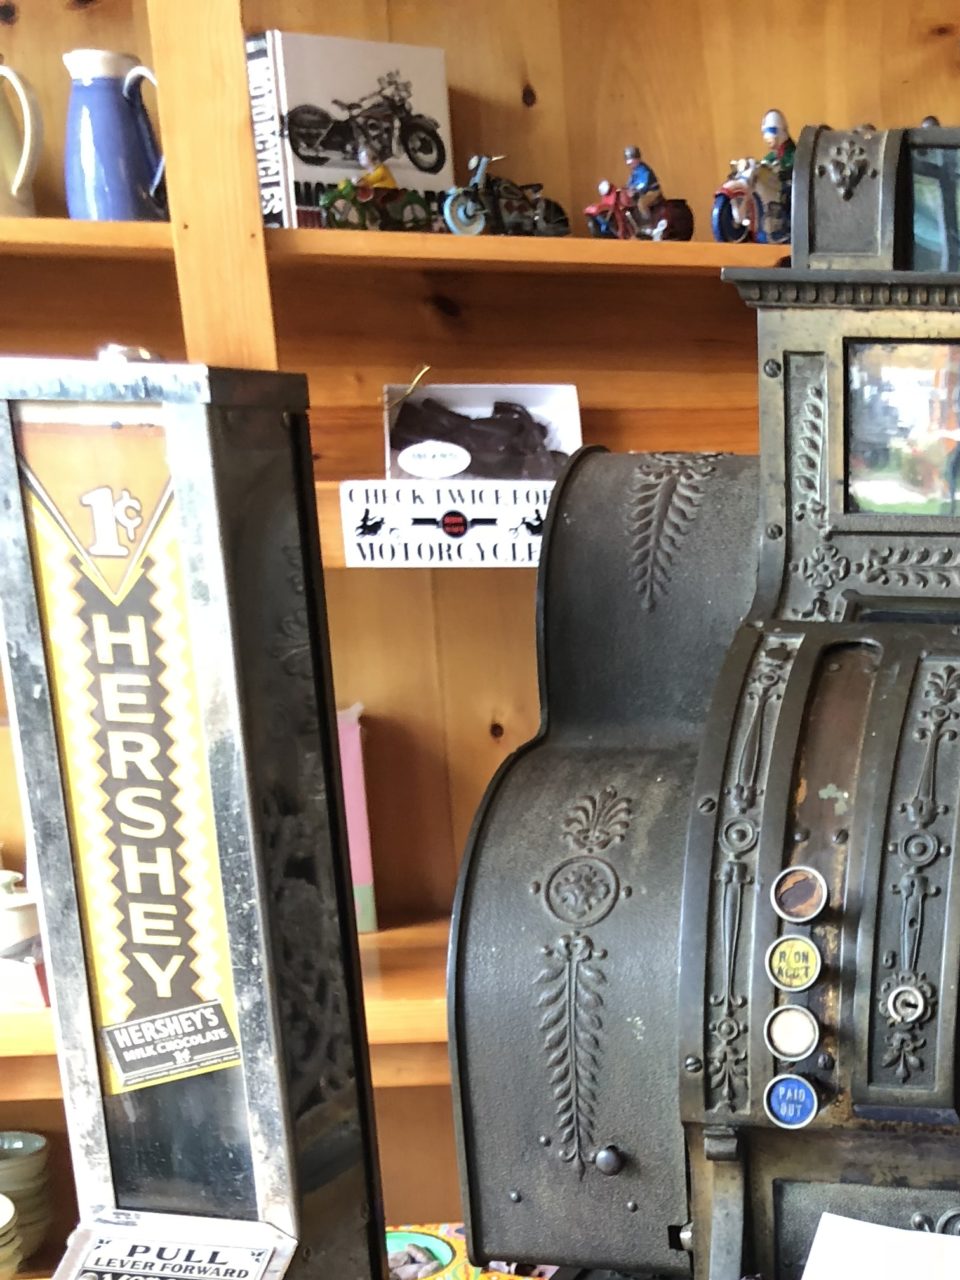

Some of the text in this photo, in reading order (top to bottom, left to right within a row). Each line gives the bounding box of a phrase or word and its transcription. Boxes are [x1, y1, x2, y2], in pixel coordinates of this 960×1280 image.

[349, 489, 424, 504] CHECK
[436, 489, 504, 505] TWICE
[356, 542, 540, 562] MOTORCYCLE
[92, 614, 187, 999] HERSHEY
[113, 1007, 219, 1049] HERSHEY'S
[156, 1027, 229, 1054] CHOCOLATE
[778, 1086, 805, 1102] PAID
[127, 1244, 228, 1265] PULL
[94, 1257, 249, 1280] LEVER FORWARD
